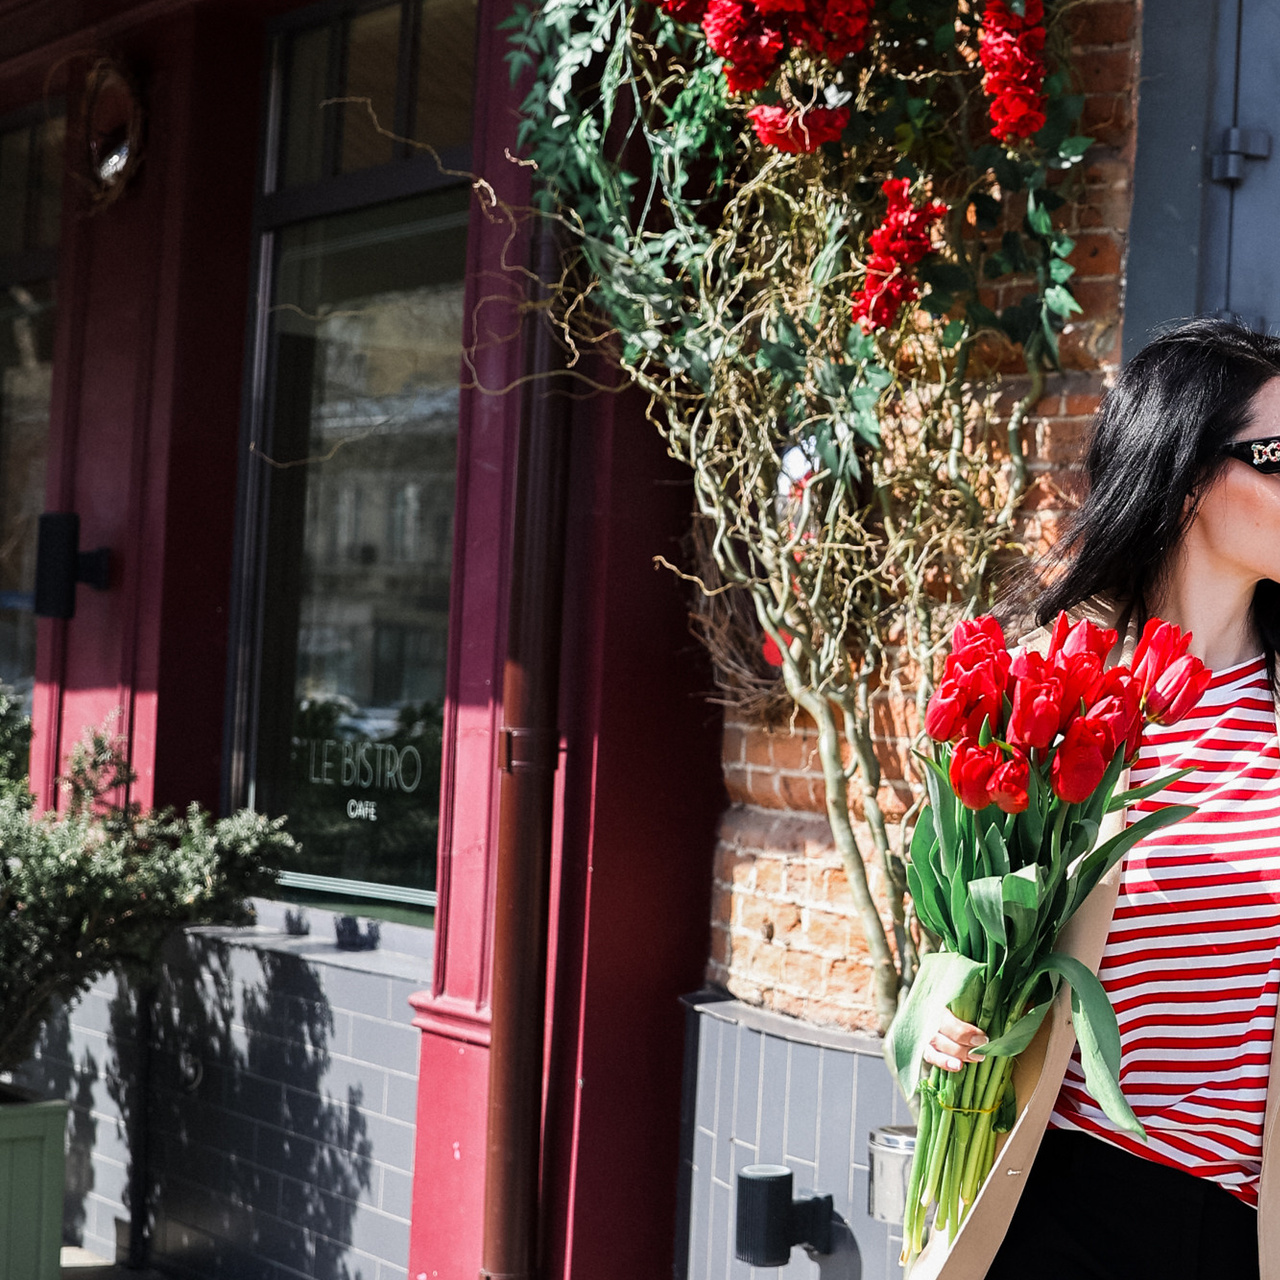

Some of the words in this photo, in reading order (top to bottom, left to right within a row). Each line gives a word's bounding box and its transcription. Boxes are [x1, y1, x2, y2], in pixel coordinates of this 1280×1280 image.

[309, 739, 336, 784] LE
[341, 740, 421, 793] BISTRO
[347, 799, 378, 821] CAFE
